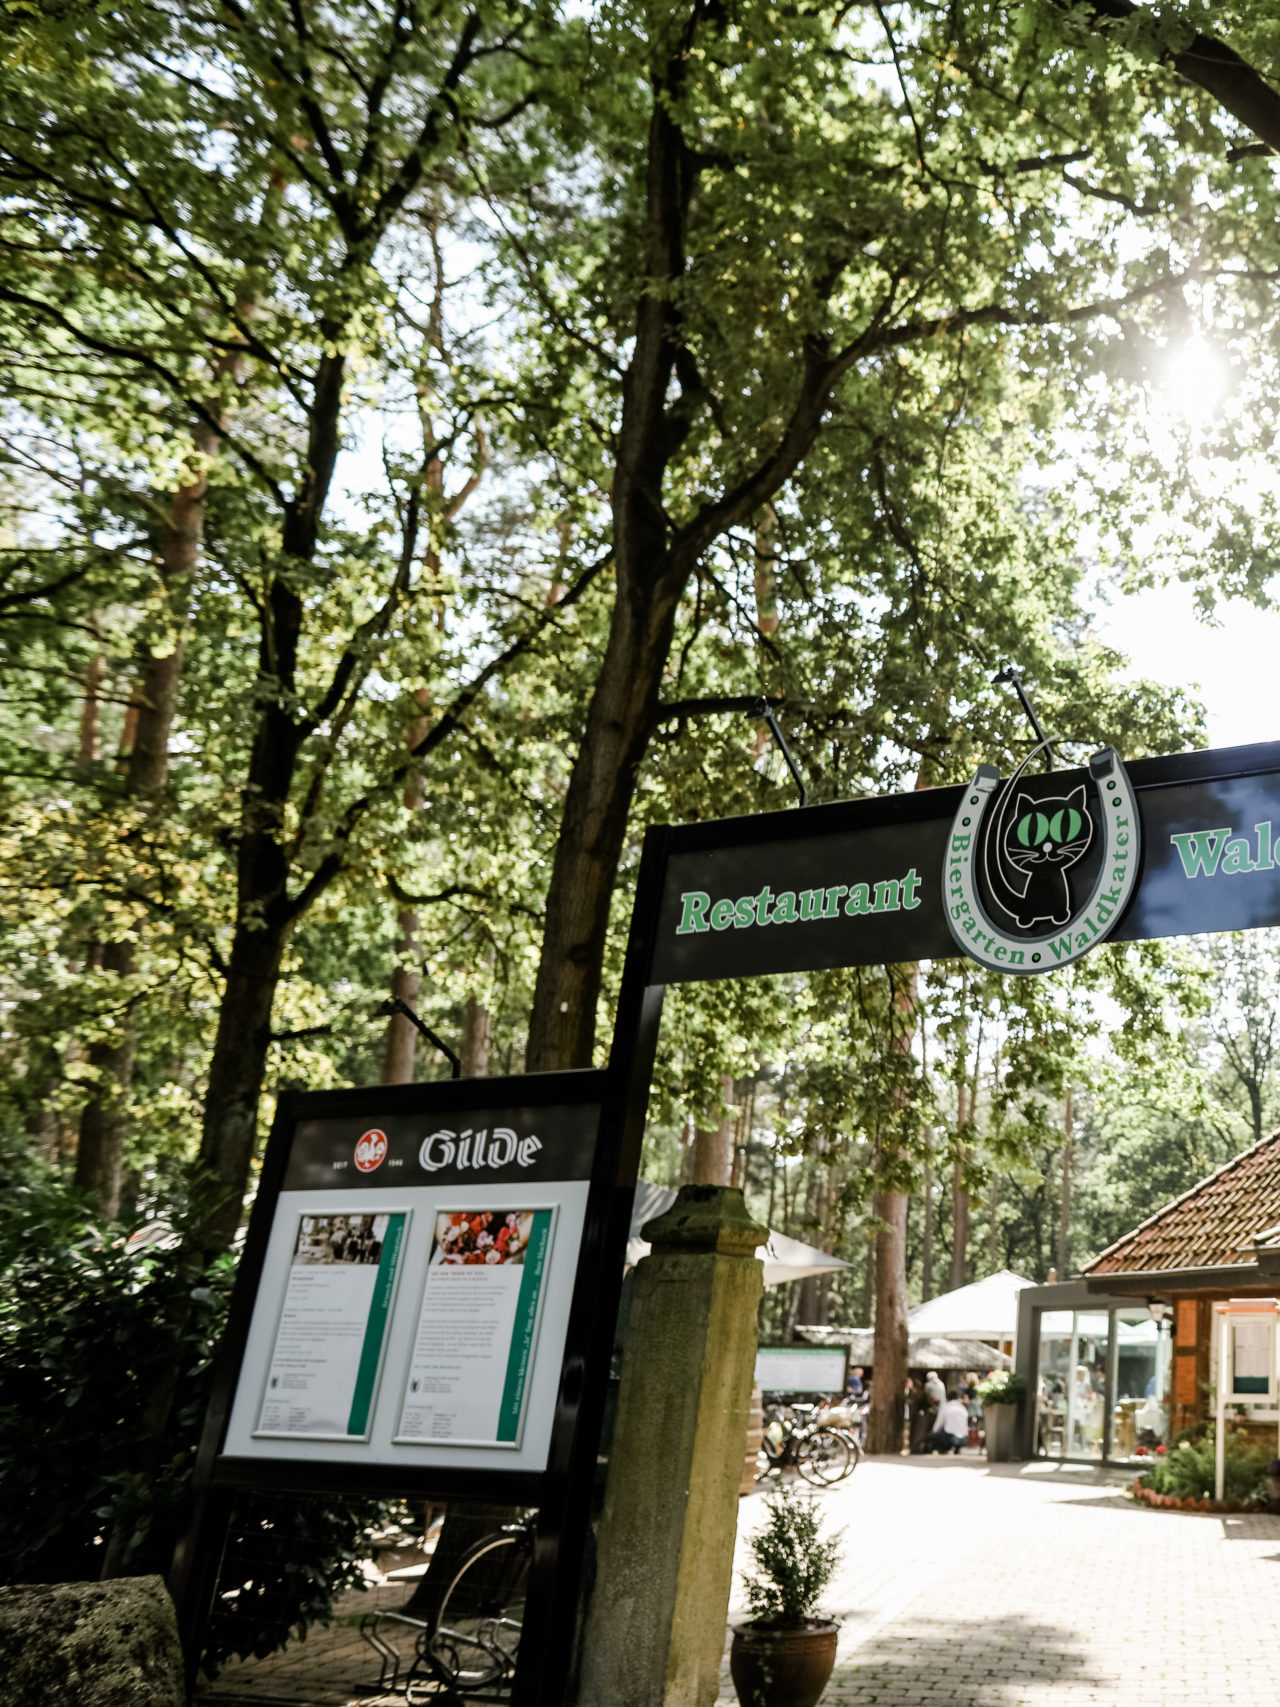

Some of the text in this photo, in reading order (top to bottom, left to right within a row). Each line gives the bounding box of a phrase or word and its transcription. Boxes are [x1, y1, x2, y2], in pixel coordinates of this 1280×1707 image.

[676, 868, 922, 935] Restaurant
[949, 815, 1129, 965] Biergarten Waldkater
